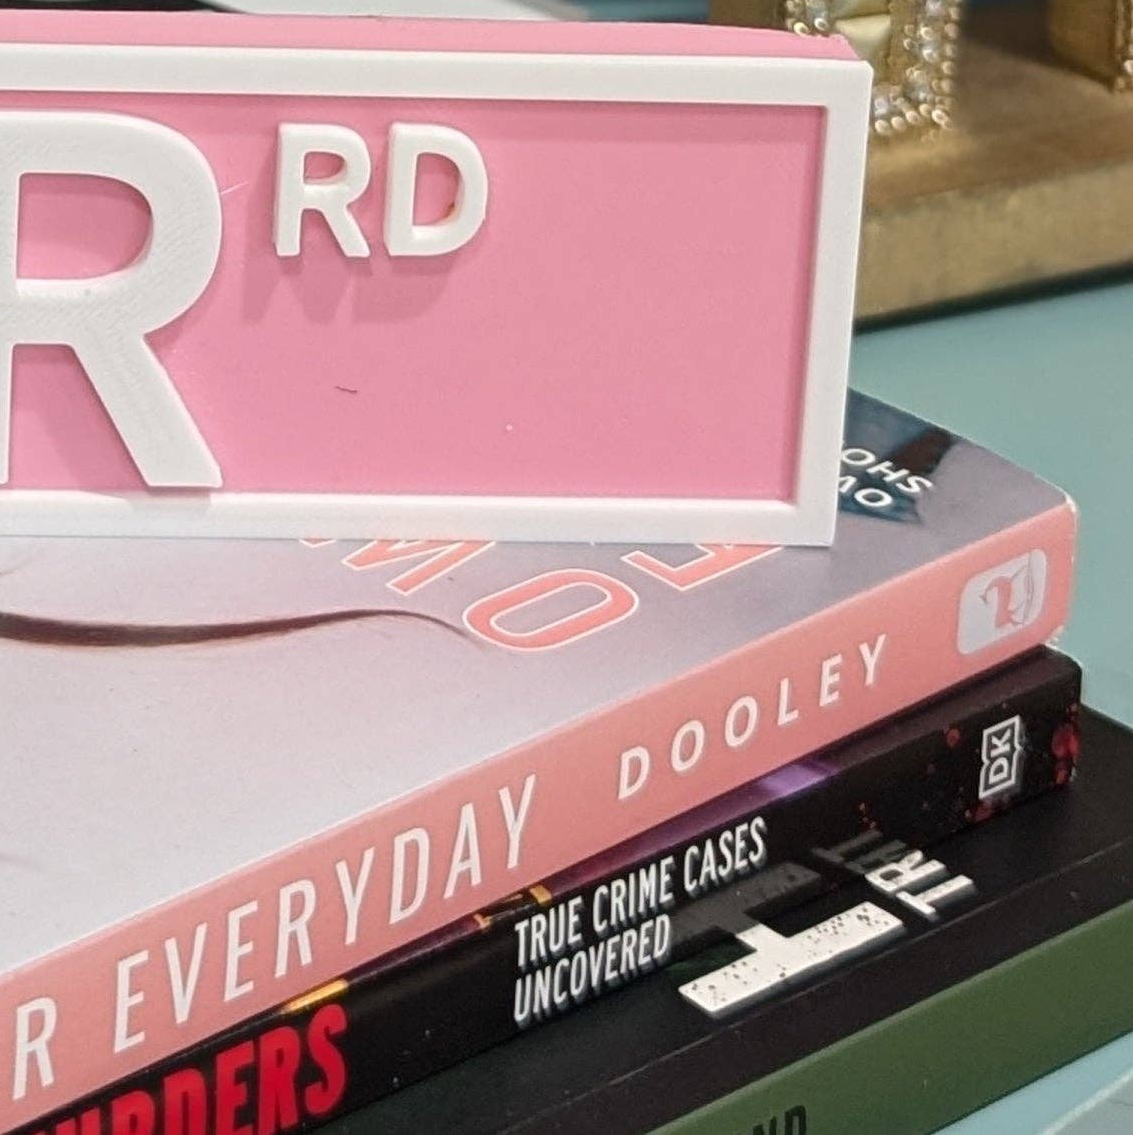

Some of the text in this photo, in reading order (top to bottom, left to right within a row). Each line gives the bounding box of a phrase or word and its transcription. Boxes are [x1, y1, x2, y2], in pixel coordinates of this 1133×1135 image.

[274, 122, 489, 258] RD
[986, 724, 1014, 789] DK
[113, 773, 538, 1054] EVERYDAY
[618, 633, 888, 801] DOOLEY
[515, 815, 766, 968] TRUE CRIME CASES
[513, 914, 671, 1021] UNCOVERED
